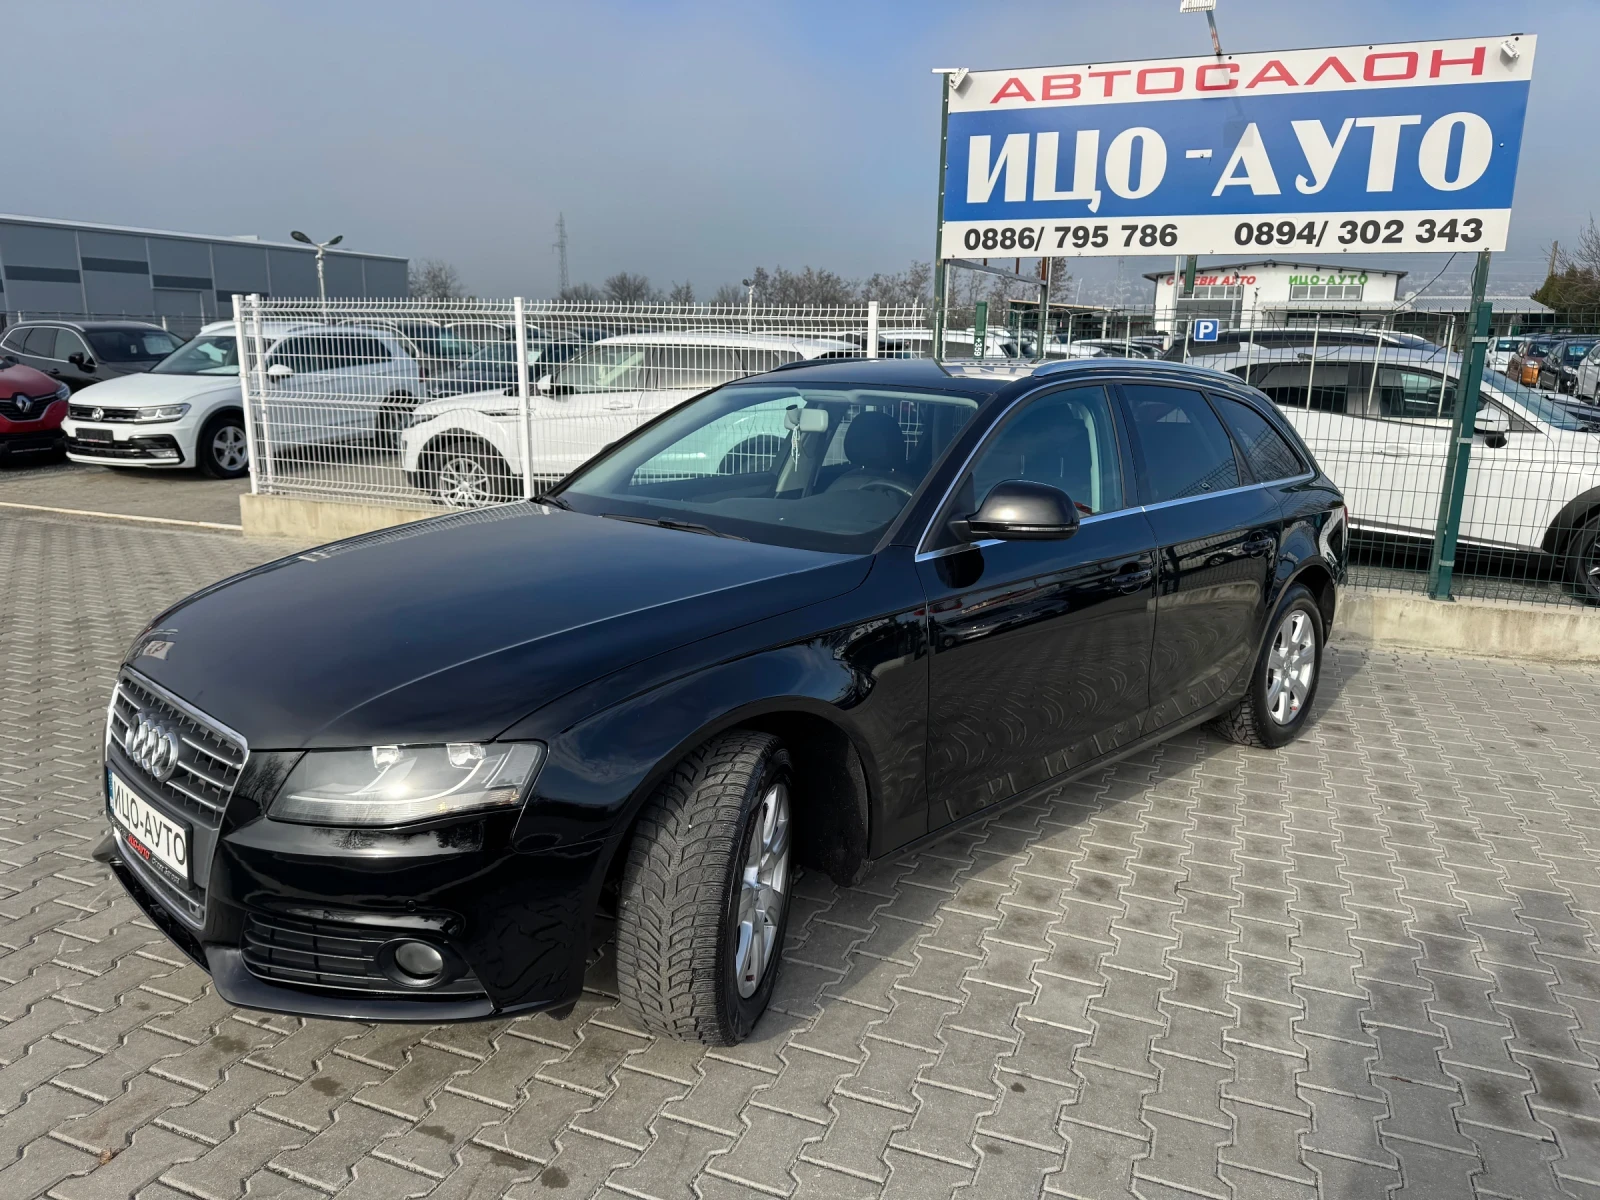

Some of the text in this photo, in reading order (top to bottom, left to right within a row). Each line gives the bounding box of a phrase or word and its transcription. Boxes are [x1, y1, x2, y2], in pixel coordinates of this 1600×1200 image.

[990, 46, 1487, 105] АВТОСАЛОН
[964, 218, 1483, 252] 0886/ 795 786 0894/ 302 343
[1288, 274, 1369, 286] ИЦО-АУТО
[1199, 322, 1214, 339] P
[974, 338, 983, 356] +359
[114, 781, 186, 866] ИЦО-АУТО
